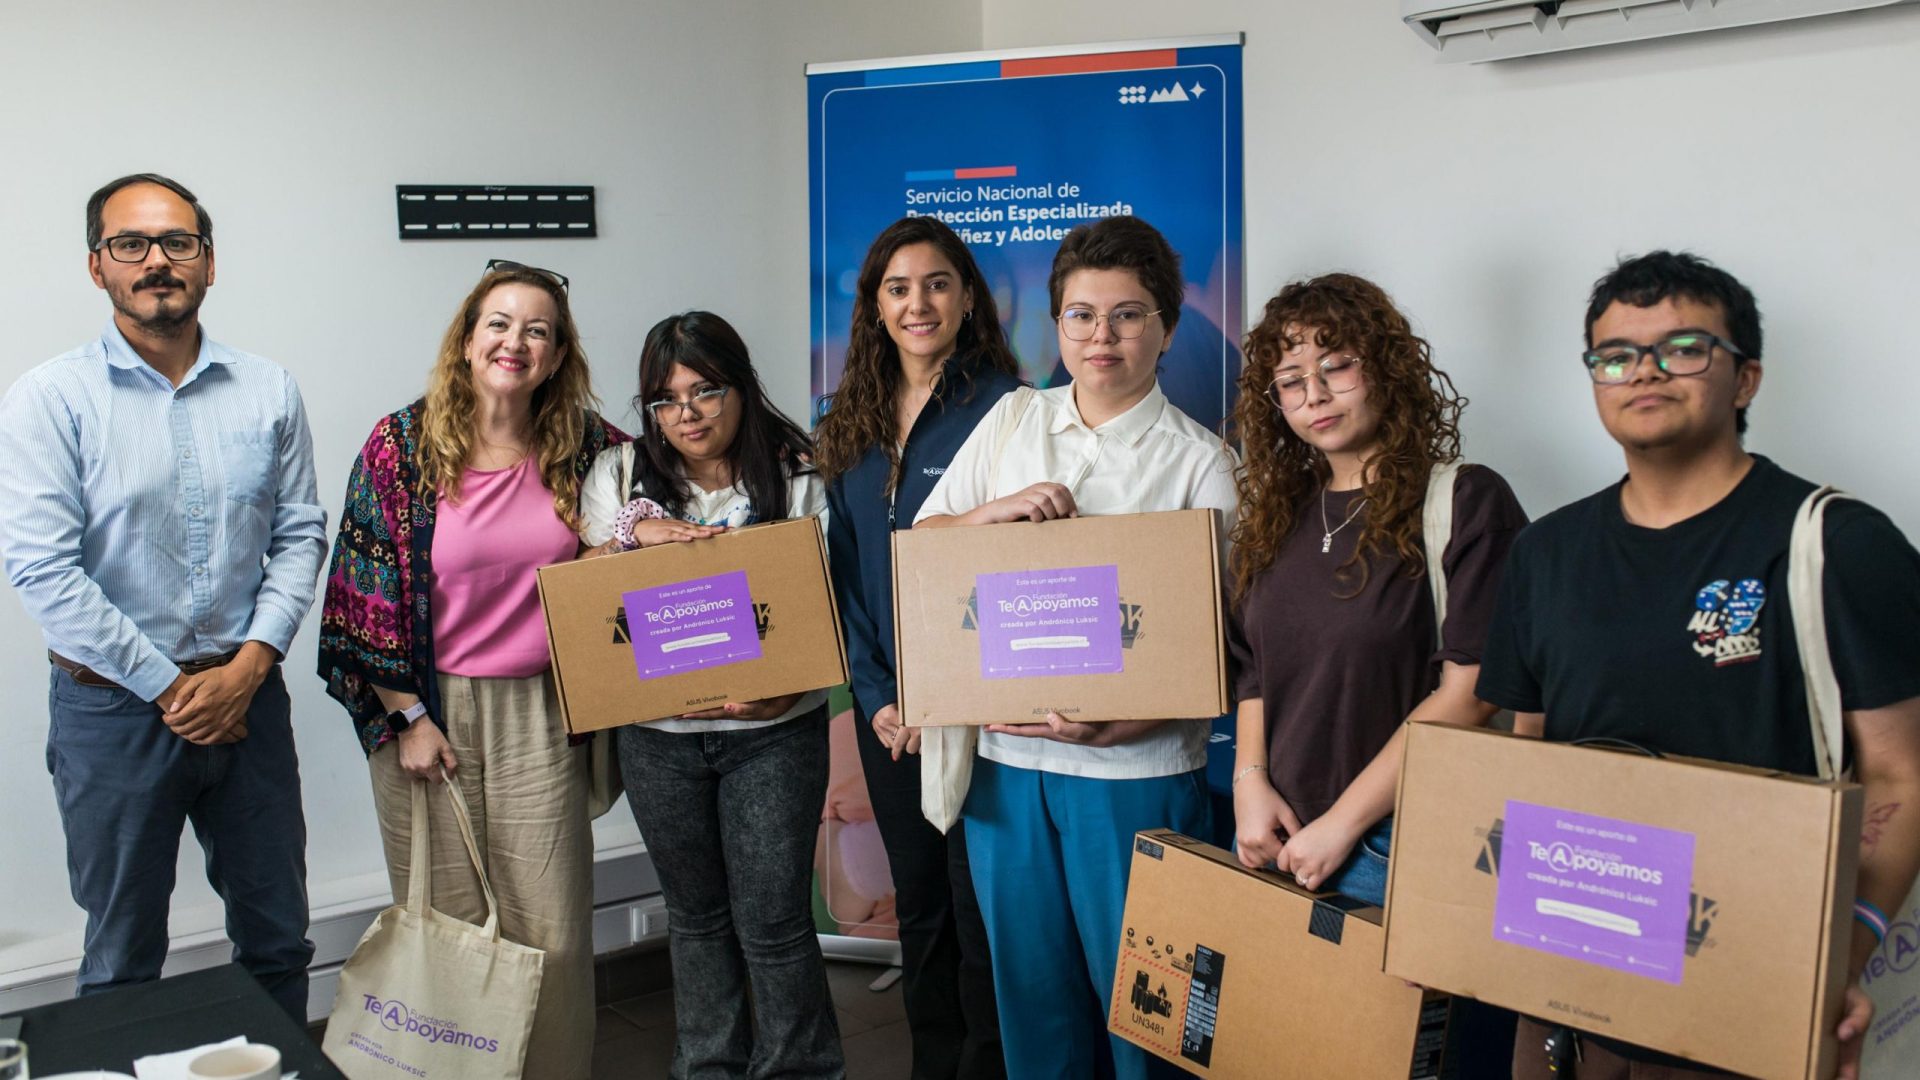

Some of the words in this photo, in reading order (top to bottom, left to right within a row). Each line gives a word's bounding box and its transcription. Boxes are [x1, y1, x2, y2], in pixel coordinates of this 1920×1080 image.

[906, 187, 972, 204] Servicio
[978, 183, 1053, 201] Nacional
[1057, 182, 1080, 198] de
[1008, 201, 1132, 224] Especializada
[951, 228, 993, 243] iñez
[995, 230, 1006, 246] y
[1009, 225, 1072, 242] Adoles
[671, 625, 682, 633] por
[409, 1008, 459, 1029] Fundación
[1131, 1012, 1165, 1036] UN3481
[396, 1060, 427, 1078] LUKSIC
